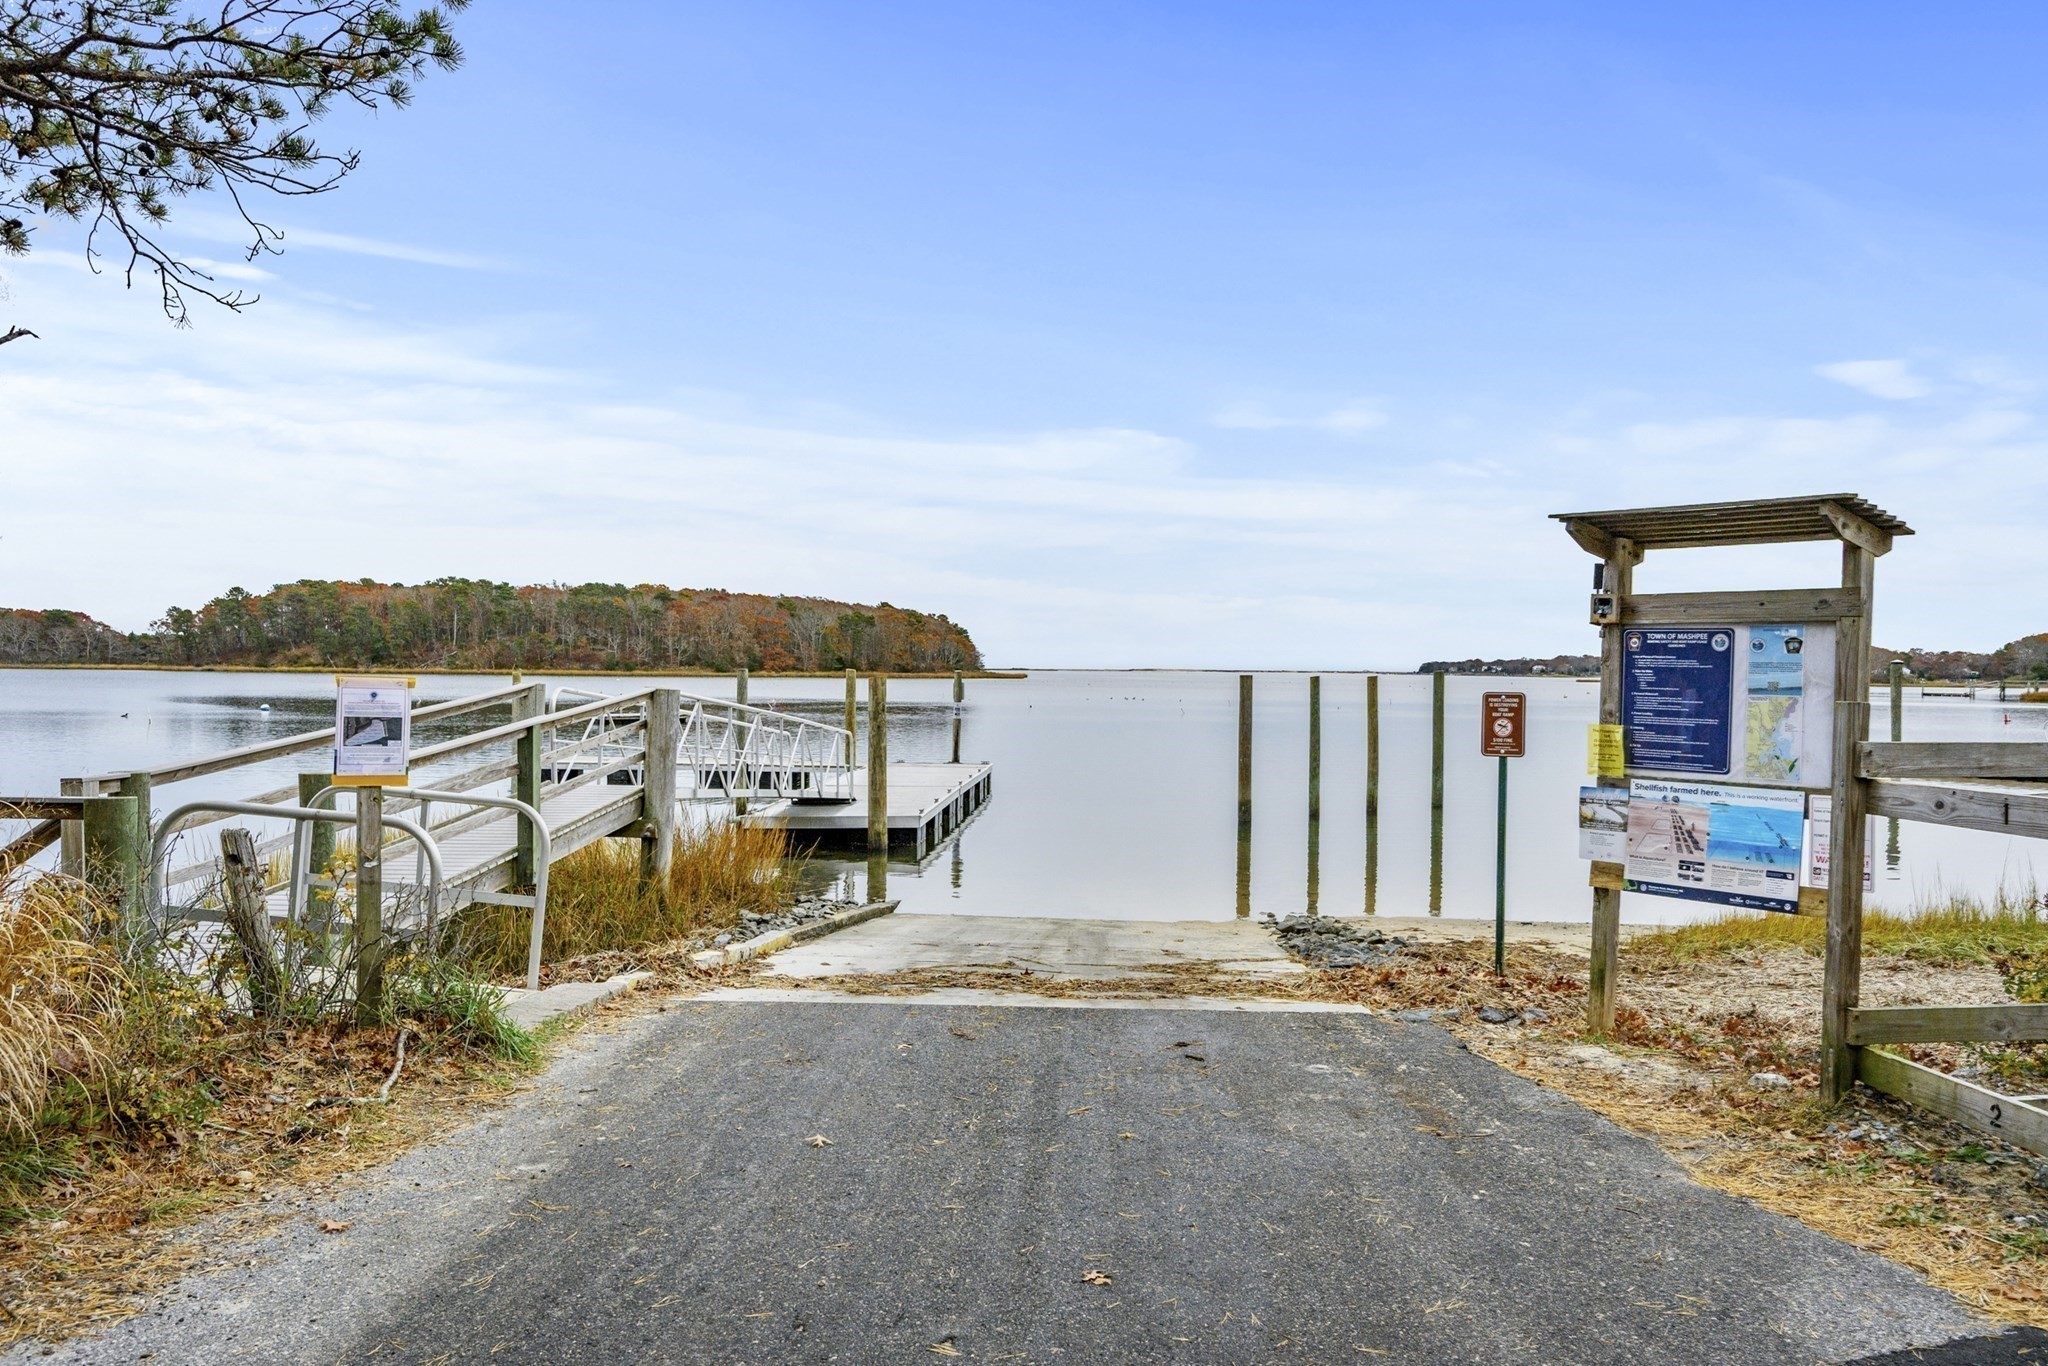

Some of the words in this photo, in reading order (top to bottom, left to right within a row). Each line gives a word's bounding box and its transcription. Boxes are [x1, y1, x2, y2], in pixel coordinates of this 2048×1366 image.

[1634, 782, 1668, 792] Shellfish
[1670, 786, 1698, 795] farmed
[1700, 788, 1722, 797] here.
[1747, 794, 1769, 802] working
[1990, 1103, 2002, 1128] 2
